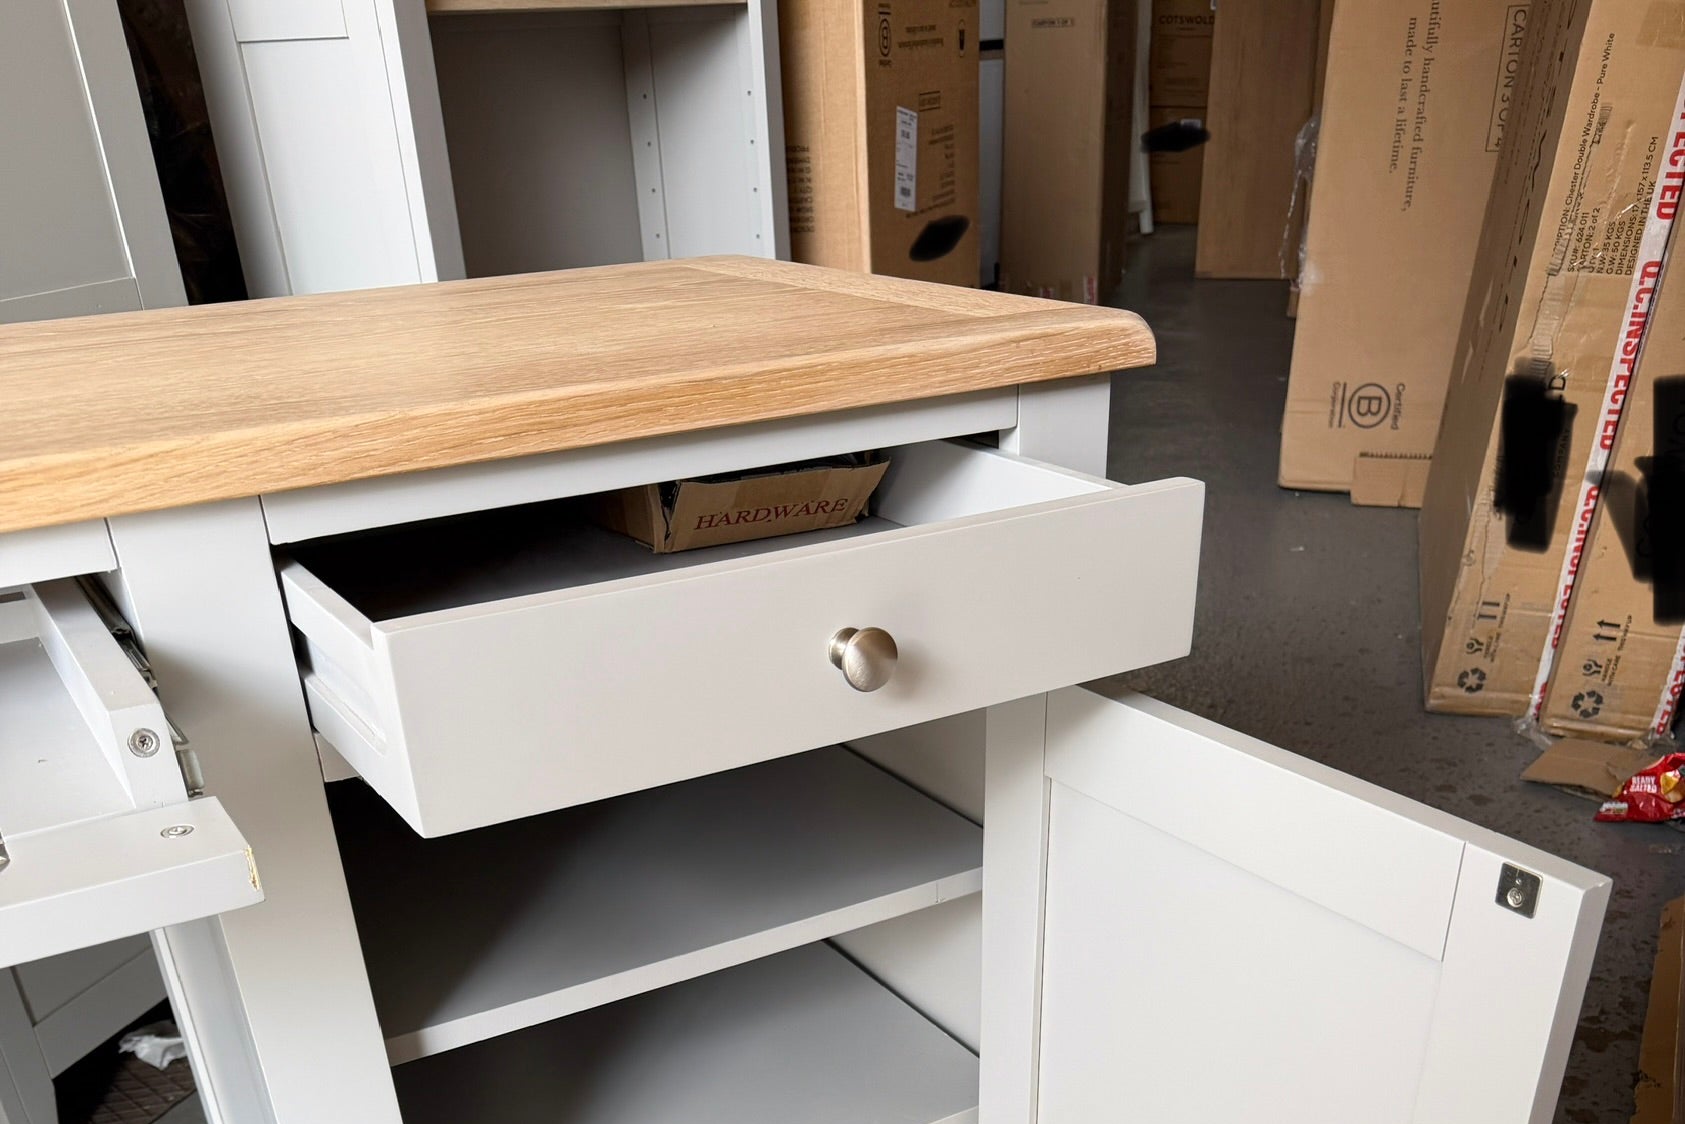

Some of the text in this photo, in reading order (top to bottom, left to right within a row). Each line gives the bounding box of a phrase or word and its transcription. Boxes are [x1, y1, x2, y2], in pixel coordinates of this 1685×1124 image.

[1159, 15, 1215, 25] COTSWOLD
[1503, 8, 1527, 88] CARTON
[1389, 17, 1418, 174] made to last a lifetime.
[1400, 0, 1441, 212] utifully handcrafted furniture,
[1565, 172, 1580, 206] Chester
[1574, 138, 1588, 170] Double
[1582, 92, 1600, 138] Wardrobe
[1596, 63, 1608, 84] Pure
[1602, 32, 1616, 62] White
[1576, 211, 1591, 243] 624.011
[1606, 221, 1616, 240] KGS
[1615, 214, 1637, 275] DIMENSIONS:
[1636, 182, 1645, 198] 157
[1642, 153, 1654, 174] 113.5
[1648, 136, 1659, 152] CM
[1624, 180, 1657, 276] DESIGNED IN THE UK
[1602, 241, 1611, 252] 35
[1606, 220, 1626, 275] G.W: 50 KGS
[1357, 395, 1382, 417] B
[1390, 382, 1406, 430] Certified
[693, 498, 849, 531] HARDWARE
